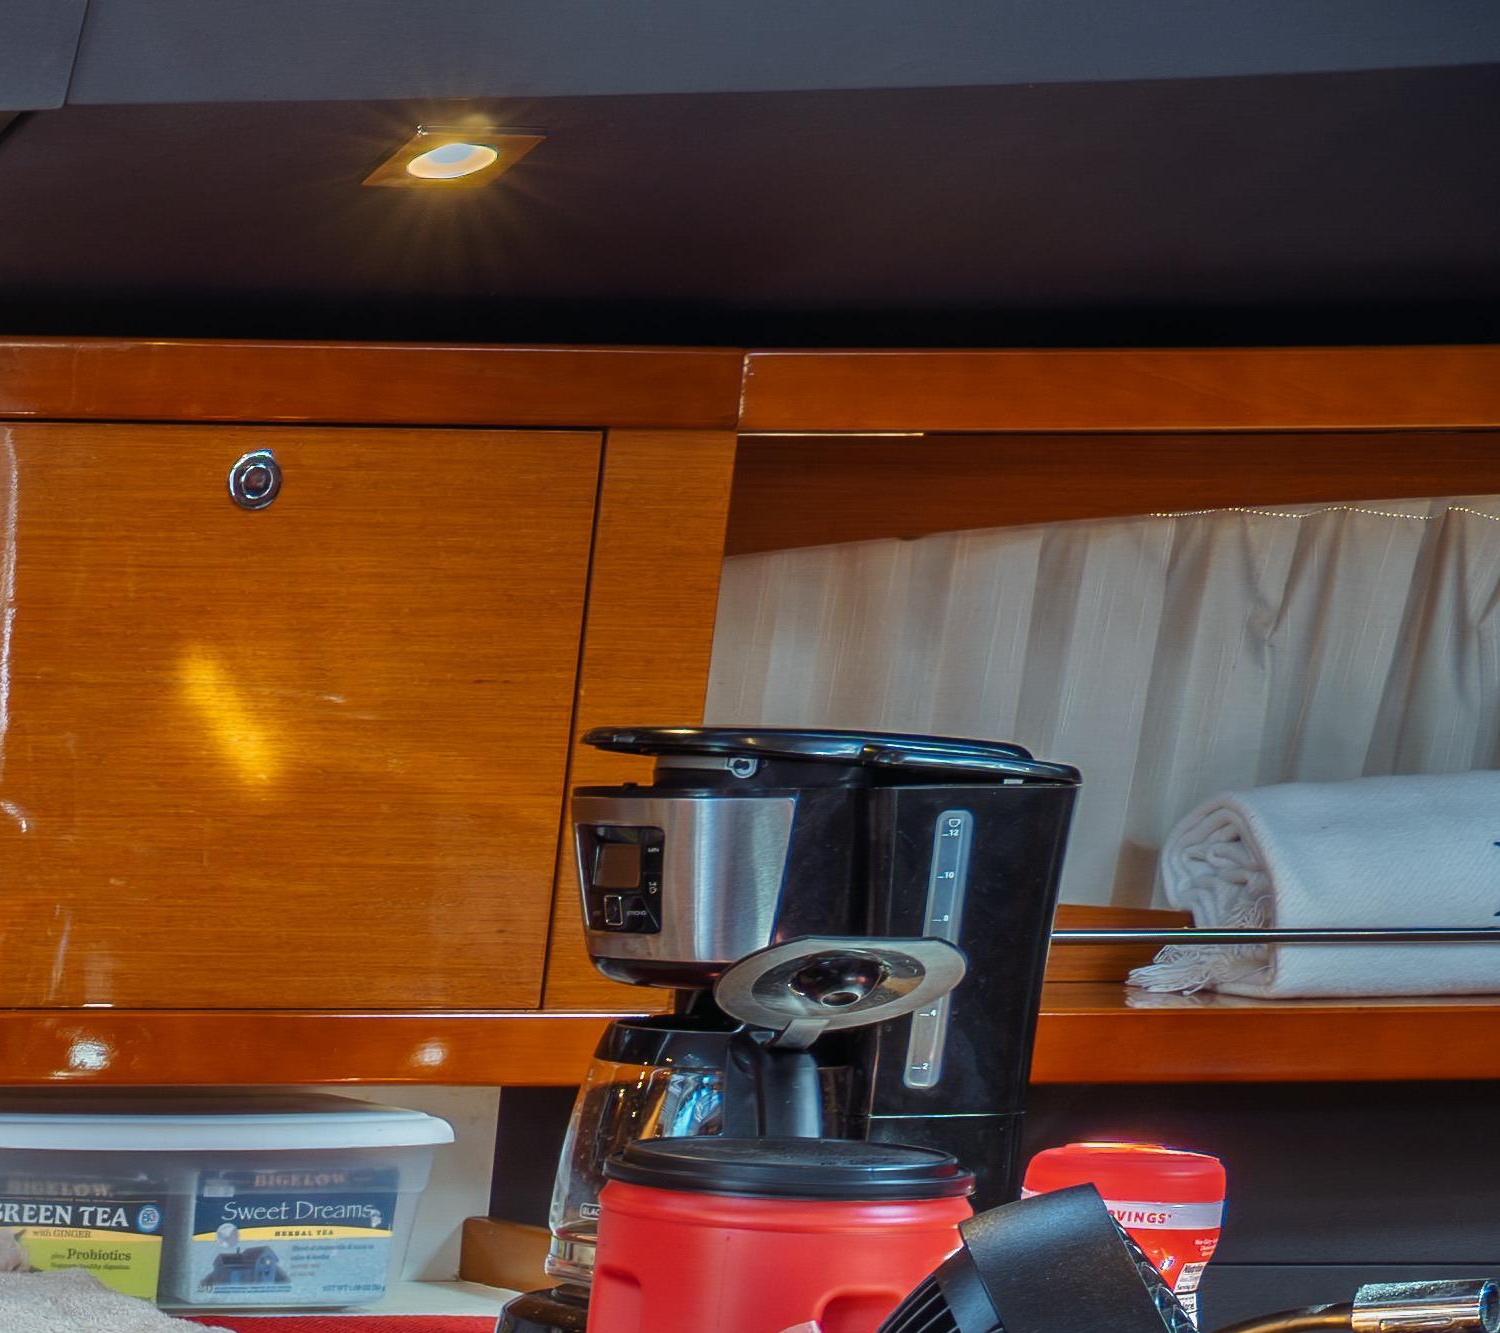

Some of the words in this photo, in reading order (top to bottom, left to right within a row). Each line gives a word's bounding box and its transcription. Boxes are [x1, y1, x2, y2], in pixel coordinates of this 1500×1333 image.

[944, 871, 955, 879] 10
[78, 1206, 130, 1228] TEA
[221, 1201, 290, 1221] Sweet
[294, 1200, 374, 1220] Dreams
[52, 1229, 92, 1239] GINGER
[66, 1248, 132, 1262] Probiotics
